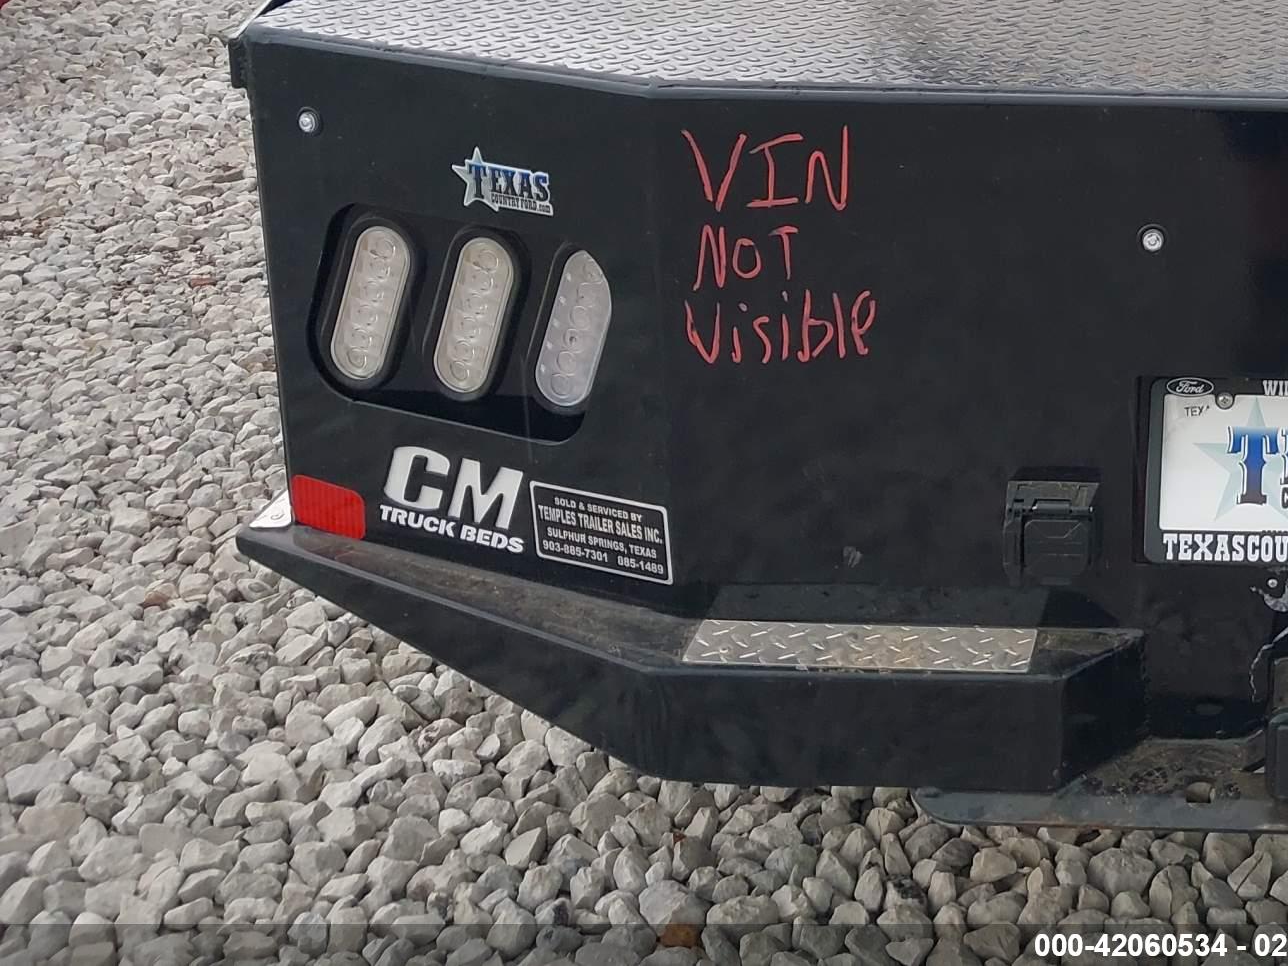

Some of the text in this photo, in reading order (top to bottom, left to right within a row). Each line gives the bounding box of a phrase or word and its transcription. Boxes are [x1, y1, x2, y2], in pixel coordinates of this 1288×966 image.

[467, 163, 549, 202] TEXAS
[681, 125, 849, 212] VIN
[491, 194, 520, 210] COUNTRY
[692, 225, 799, 290] NOT
[1175, 380, 1205, 394] Ford
[383, 446, 524, 530] CM
[379, 505, 524, 553] TRUCK BEDS
[538, 504, 663, 544] TEMPLES TRAILER SALES INC.
[554, 497, 642, 523] SOLD & SERVICED BY
[547, 526, 656, 559] SULPHUR SPRINGS, TEXAS
